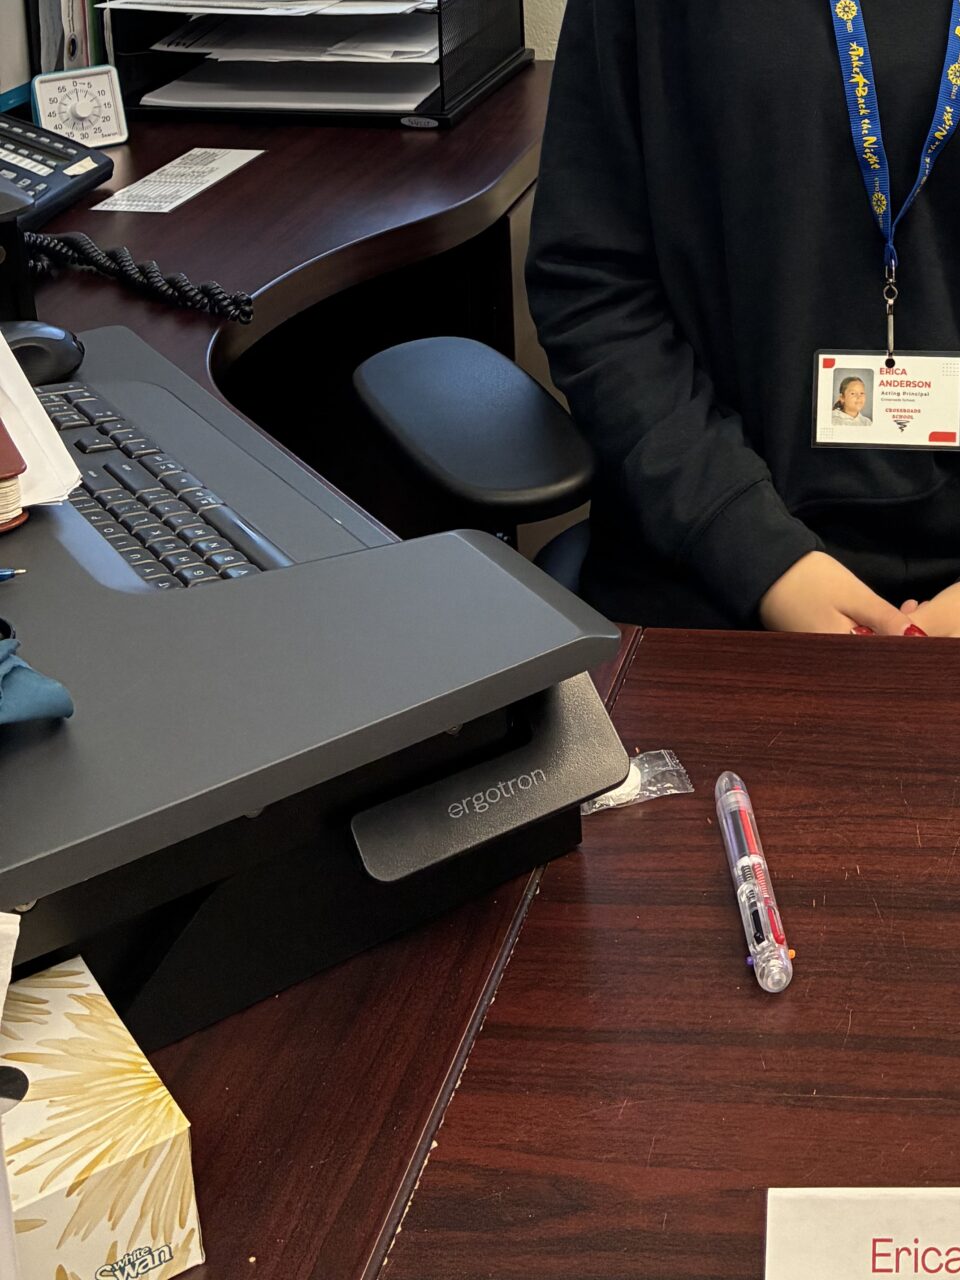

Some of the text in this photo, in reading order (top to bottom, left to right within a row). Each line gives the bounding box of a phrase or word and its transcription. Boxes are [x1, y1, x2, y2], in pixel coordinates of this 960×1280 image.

[856, 86, 870, 115] Back
[861, 119, 872, 135] the
[934, 105, 954, 140] Night
[862, 136, 881, 170] Night
[879, 368, 908, 376] ERICA
[879, 380, 931, 388] ANDERSON
[447, 766, 547, 820] ergotron
[95, 1244, 173, 1280] Swan
[113, 1246, 151, 1269] white
